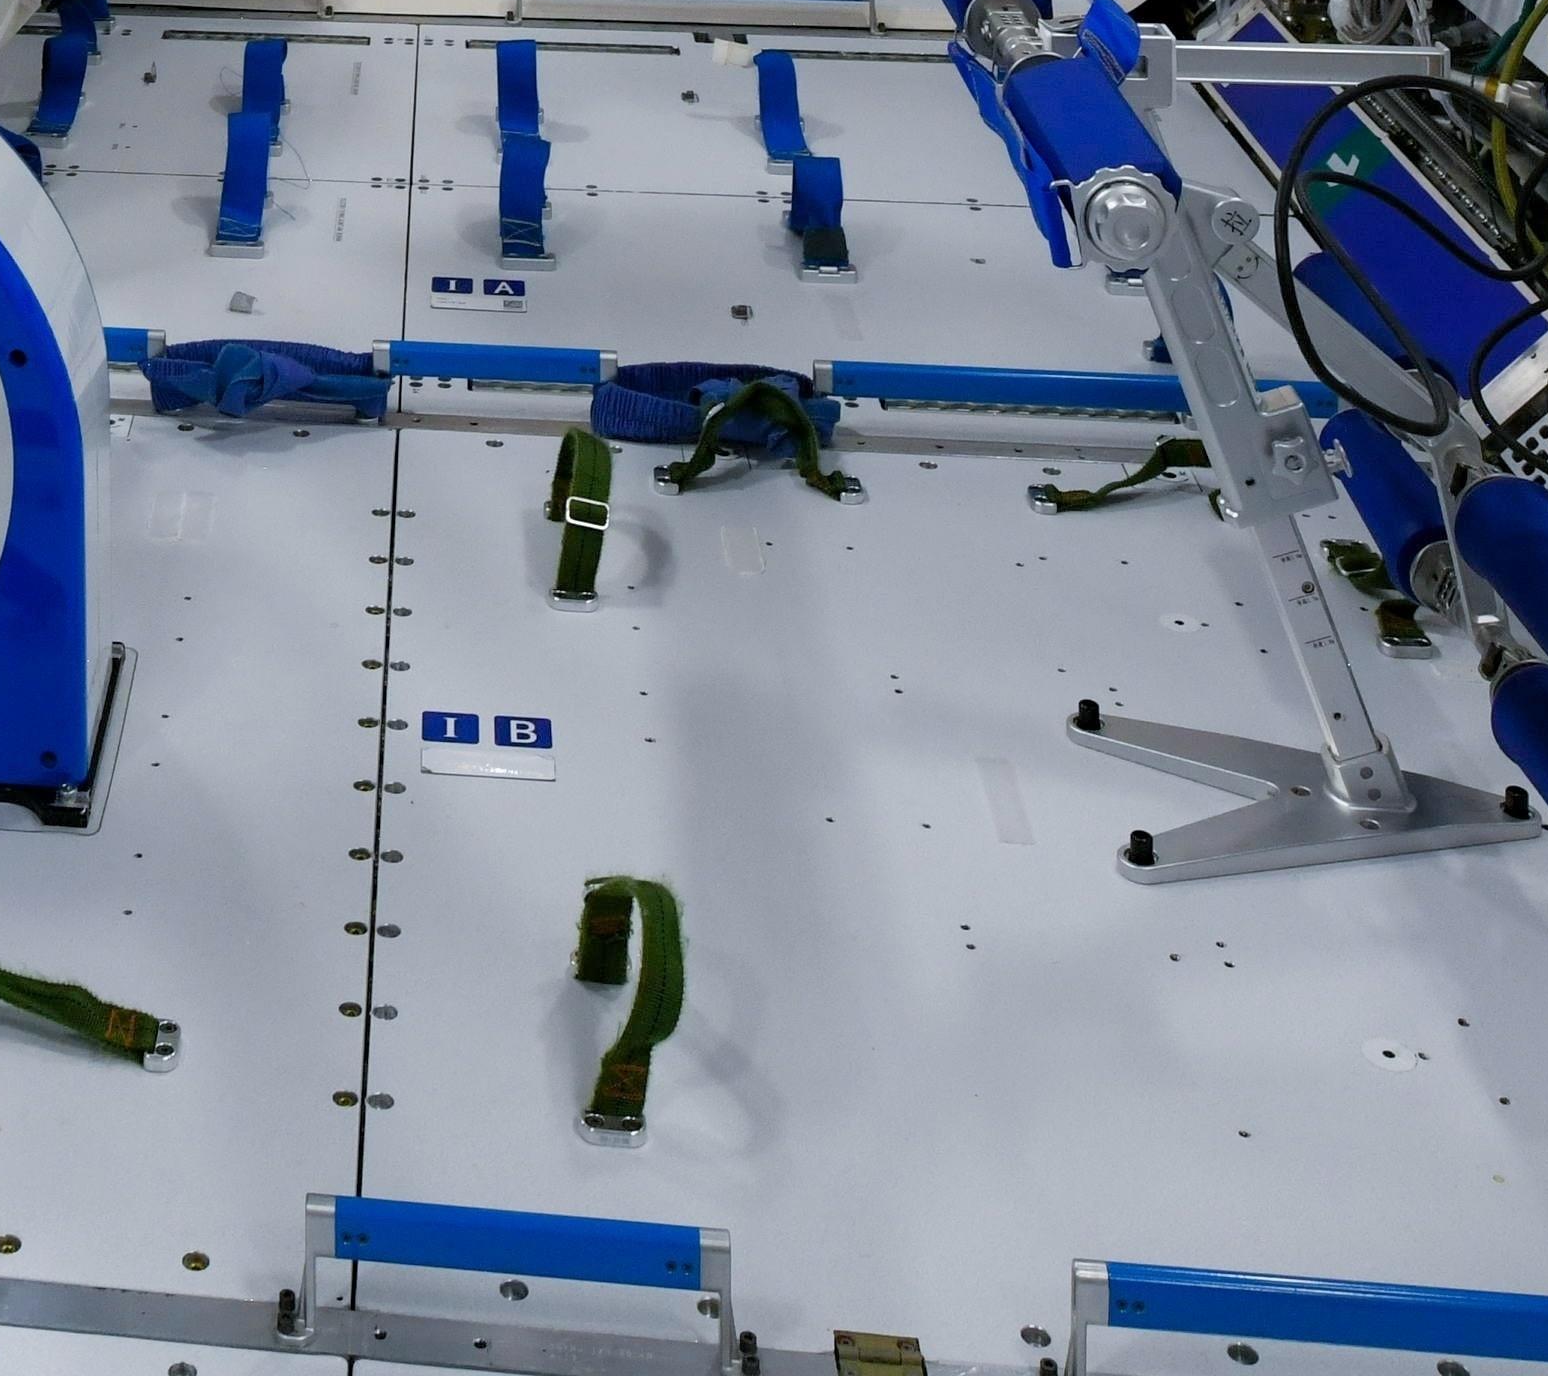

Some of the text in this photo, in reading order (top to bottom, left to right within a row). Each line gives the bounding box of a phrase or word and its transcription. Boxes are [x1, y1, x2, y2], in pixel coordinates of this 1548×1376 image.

[1221, 211, 1253, 236] 拉
[492, 281, 516, 294] A
[442, 716, 538, 743] I B
